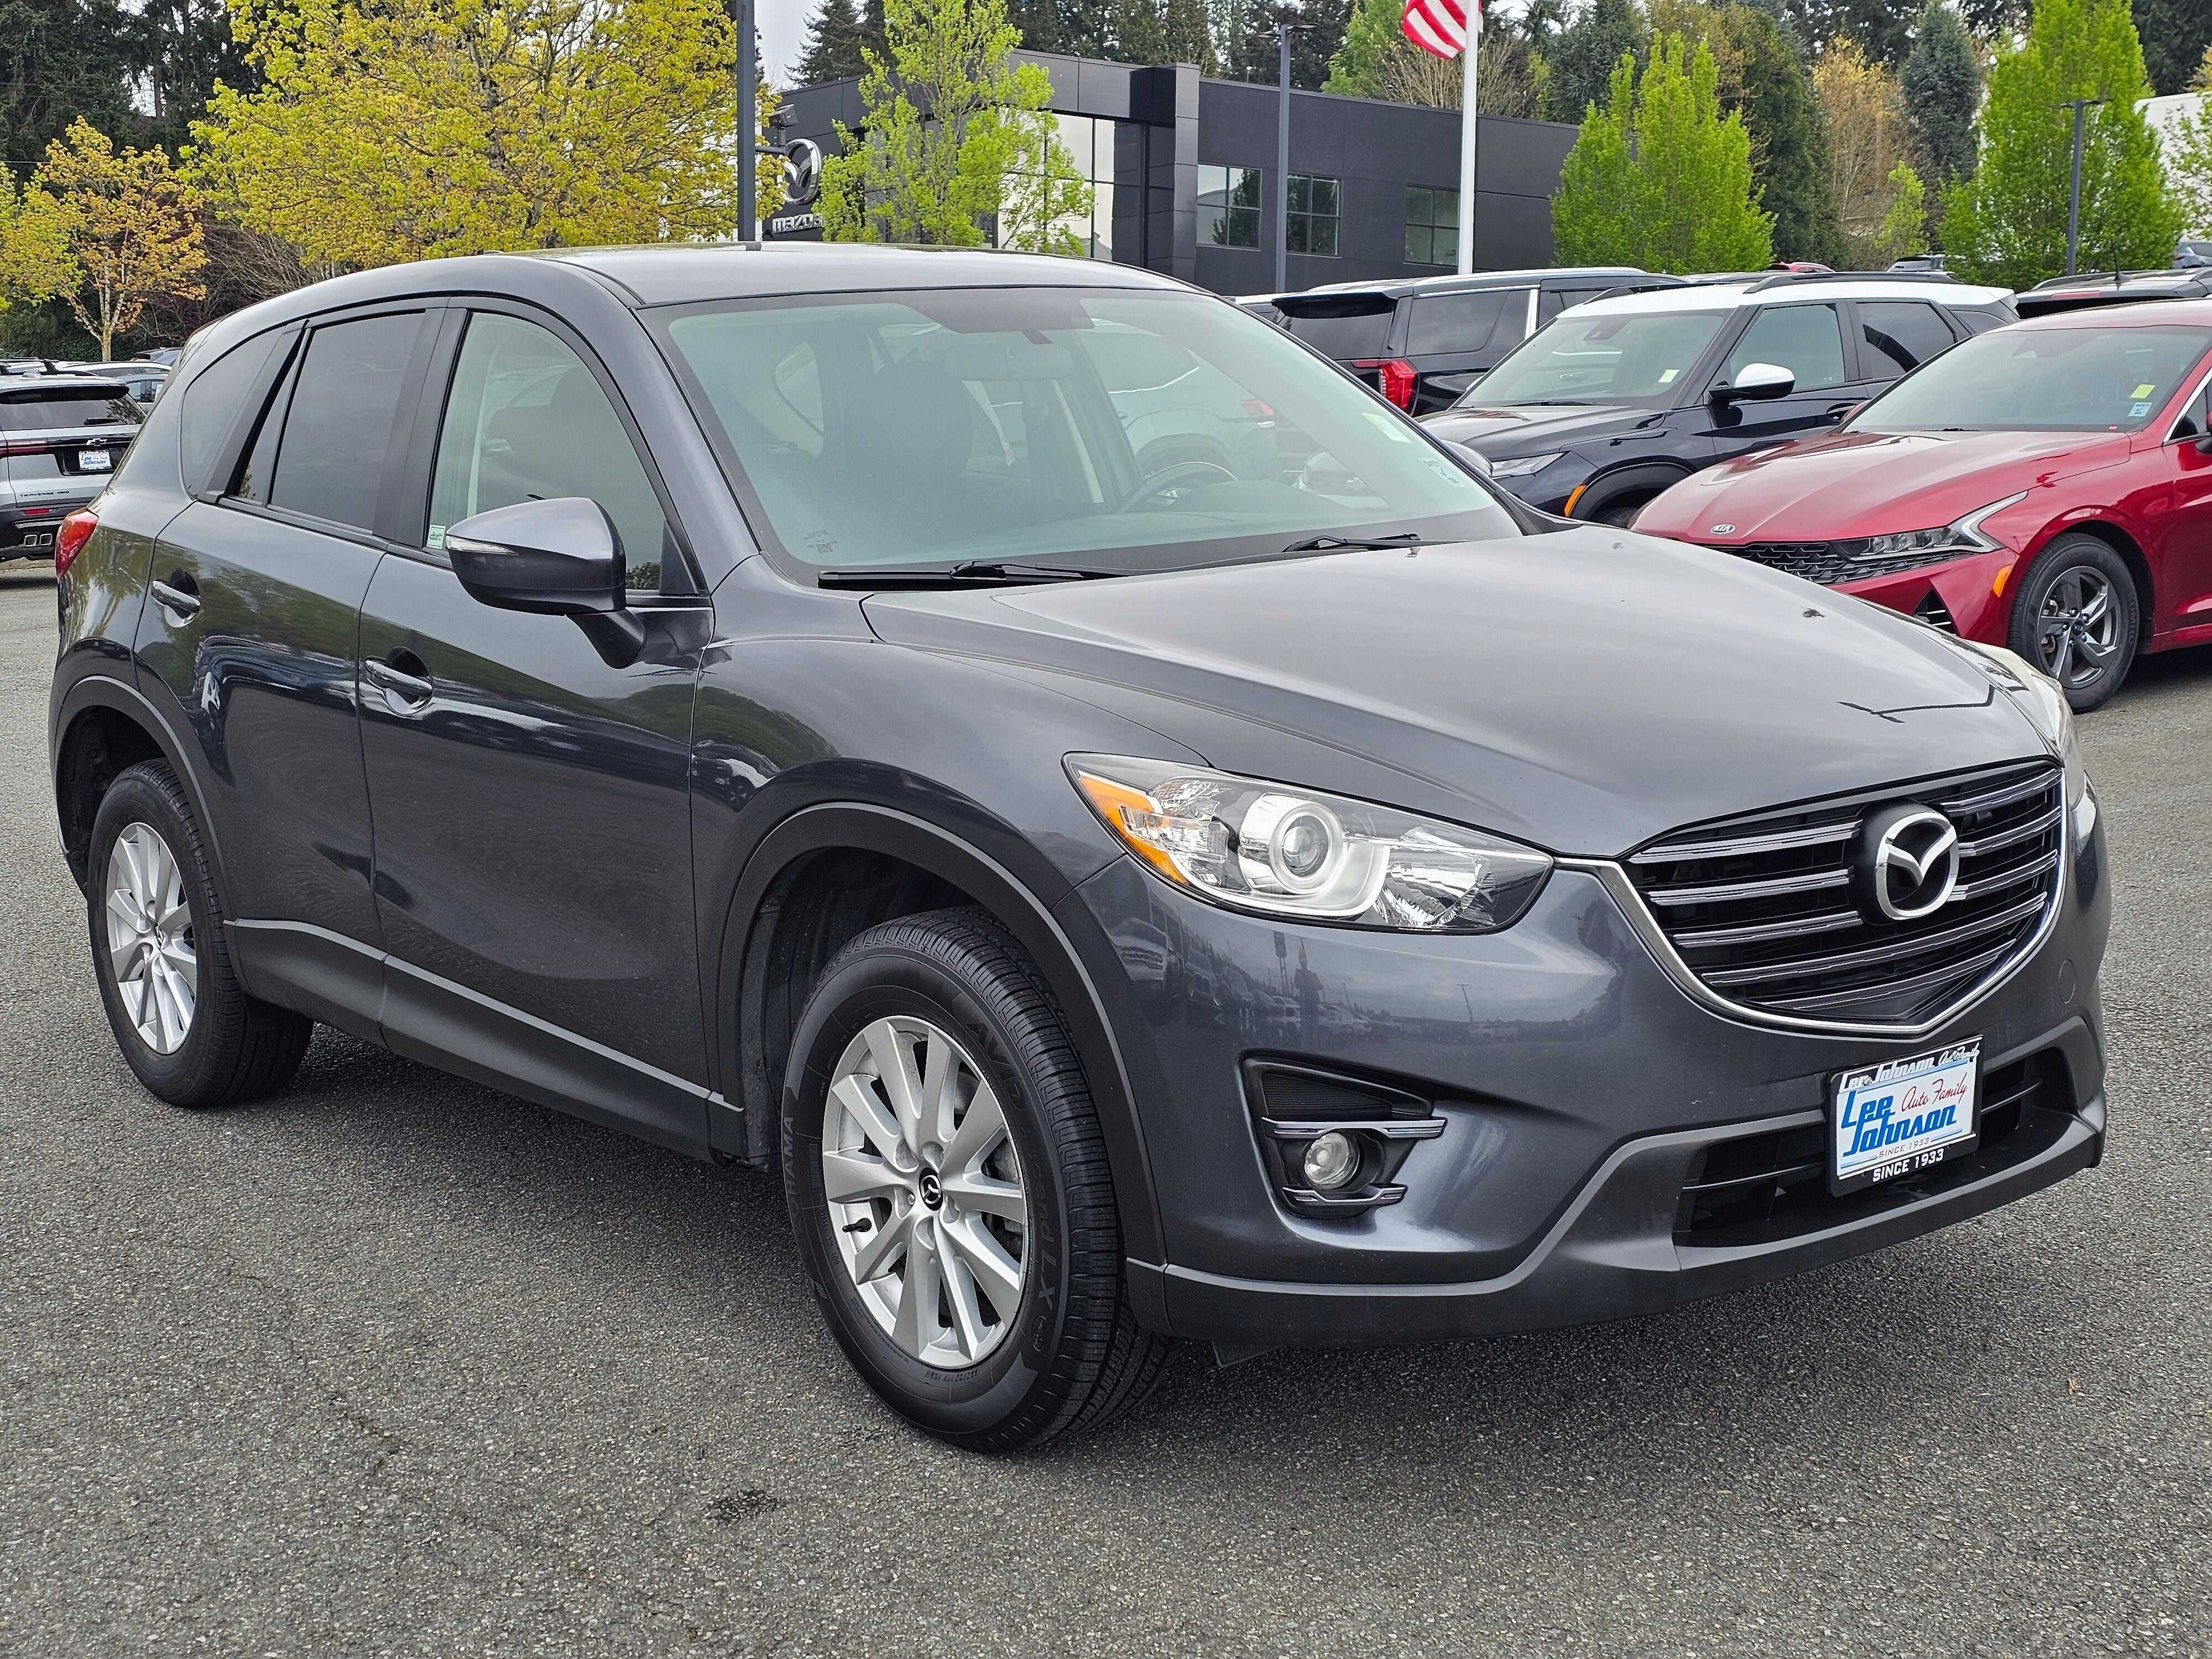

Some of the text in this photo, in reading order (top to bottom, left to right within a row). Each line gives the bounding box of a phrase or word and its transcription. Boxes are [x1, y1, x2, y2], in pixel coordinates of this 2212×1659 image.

[772, 213, 825, 233] mazda
[1712, 524, 1734, 533] KIA
[1871, 1057, 1935, 1084] Johnson
[1901, 1072, 1968, 1112] Auto Family
[1840, 1091, 1895, 1129] Lee
[1843, 1104, 1957, 1157] Johnson
[1878, 1137, 1930, 1158] SINCE 1933
[1872, 1149, 1944, 1182] SINCE 1933
